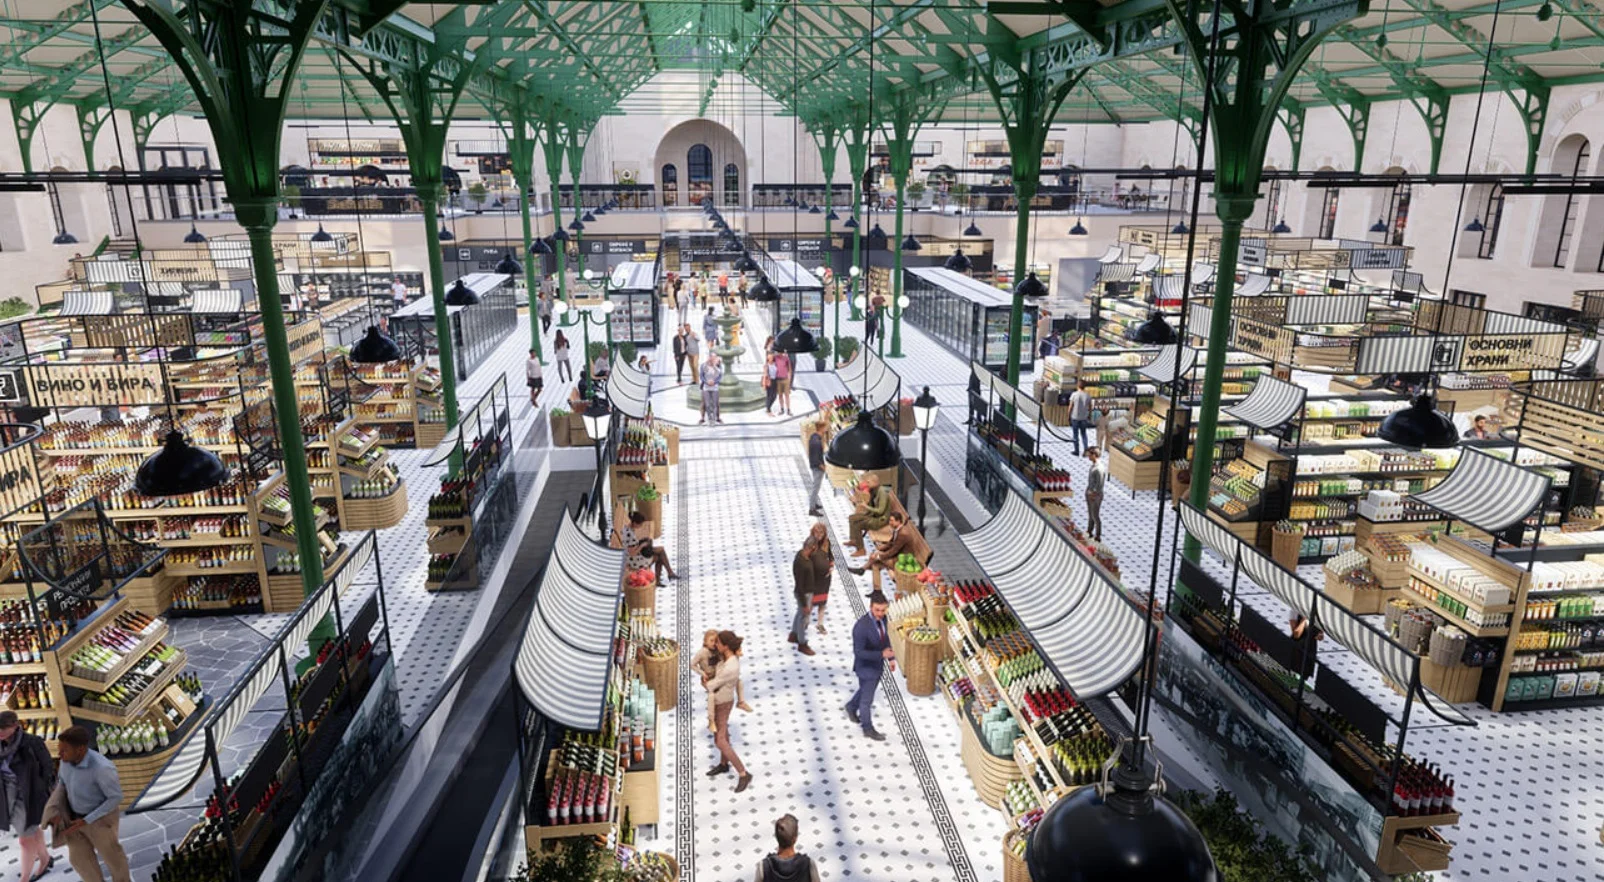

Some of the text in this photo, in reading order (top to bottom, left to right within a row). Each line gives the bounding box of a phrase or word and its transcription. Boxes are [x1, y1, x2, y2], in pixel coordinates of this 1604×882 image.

[1469, 339, 1533, 351] ОСНОВНИ
[1467, 354, 1510, 366] ХРАНИ
[37, 379, 85, 392] ВИНО
[89, 379, 102, 392] И
